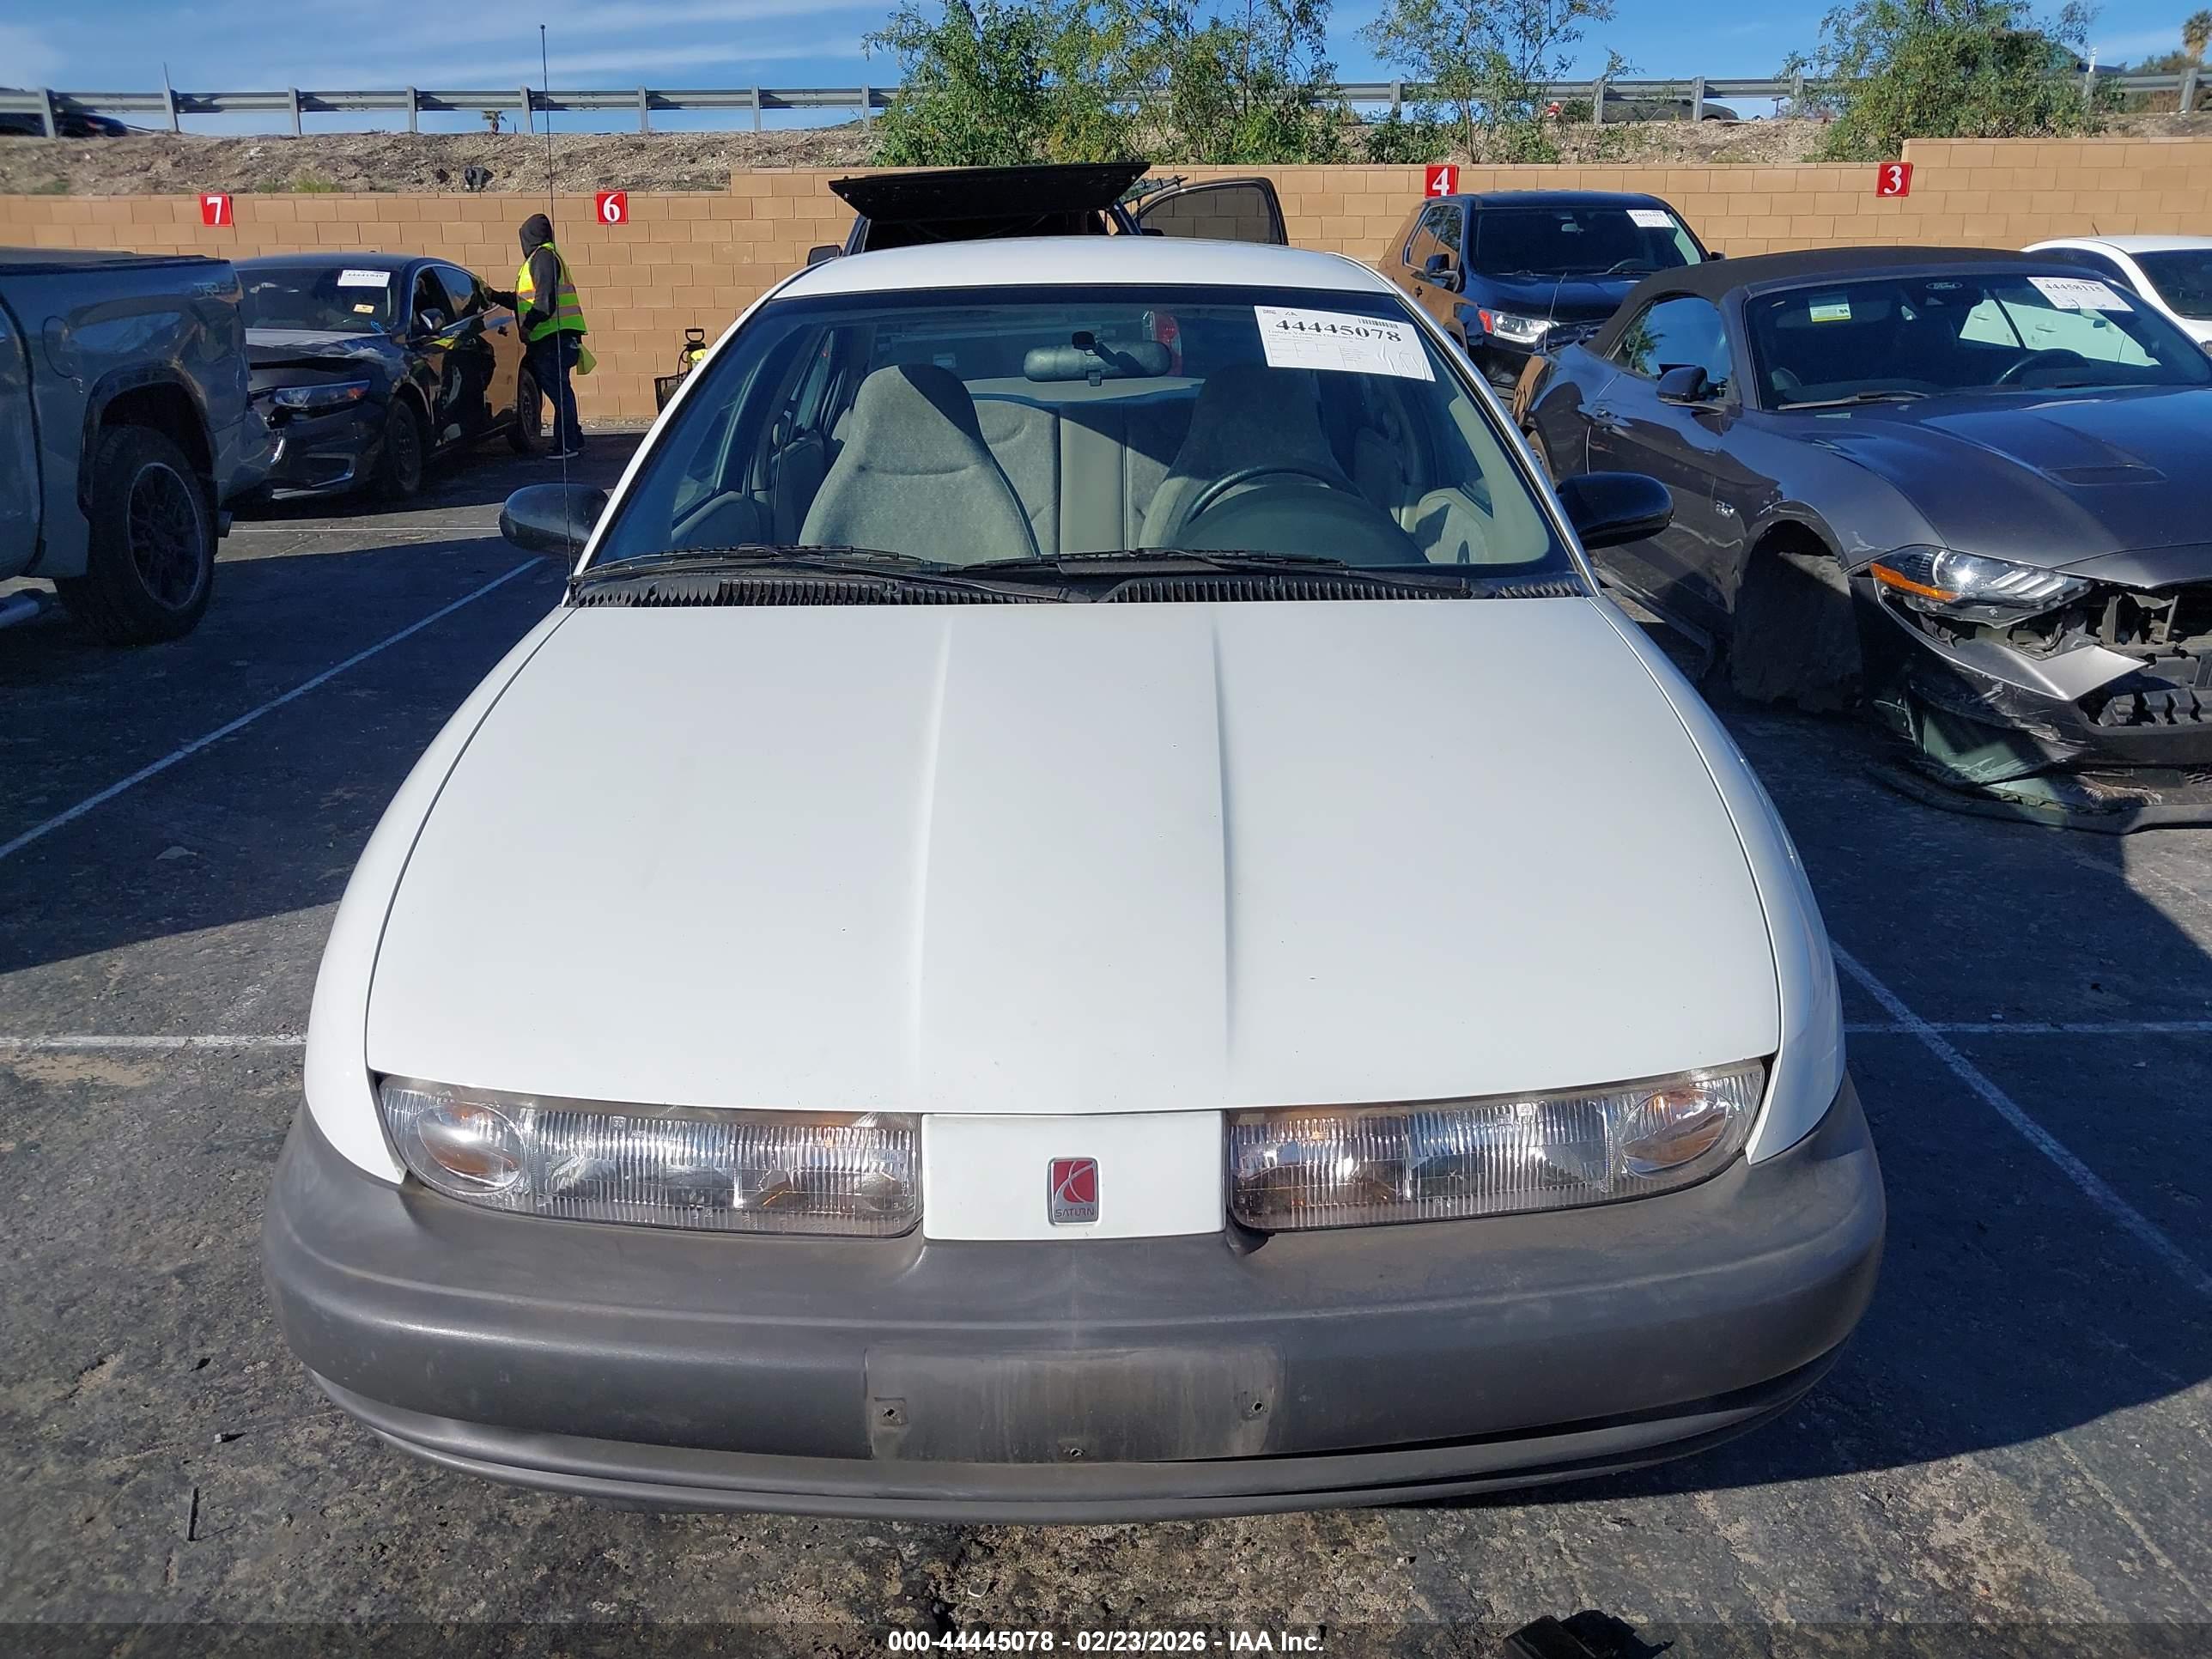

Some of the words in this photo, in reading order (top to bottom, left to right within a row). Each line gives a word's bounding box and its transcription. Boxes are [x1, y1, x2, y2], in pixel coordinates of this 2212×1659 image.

[1431, 167, 1450, 196] 4
[1884, 165, 1902, 194] 3
[206, 197, 223, 224] 7
[603, 193, 621, 222] 6
[1275, 319, 1402, 343] 44445078
[1055, 1207, 1095, 1218] SATURN
